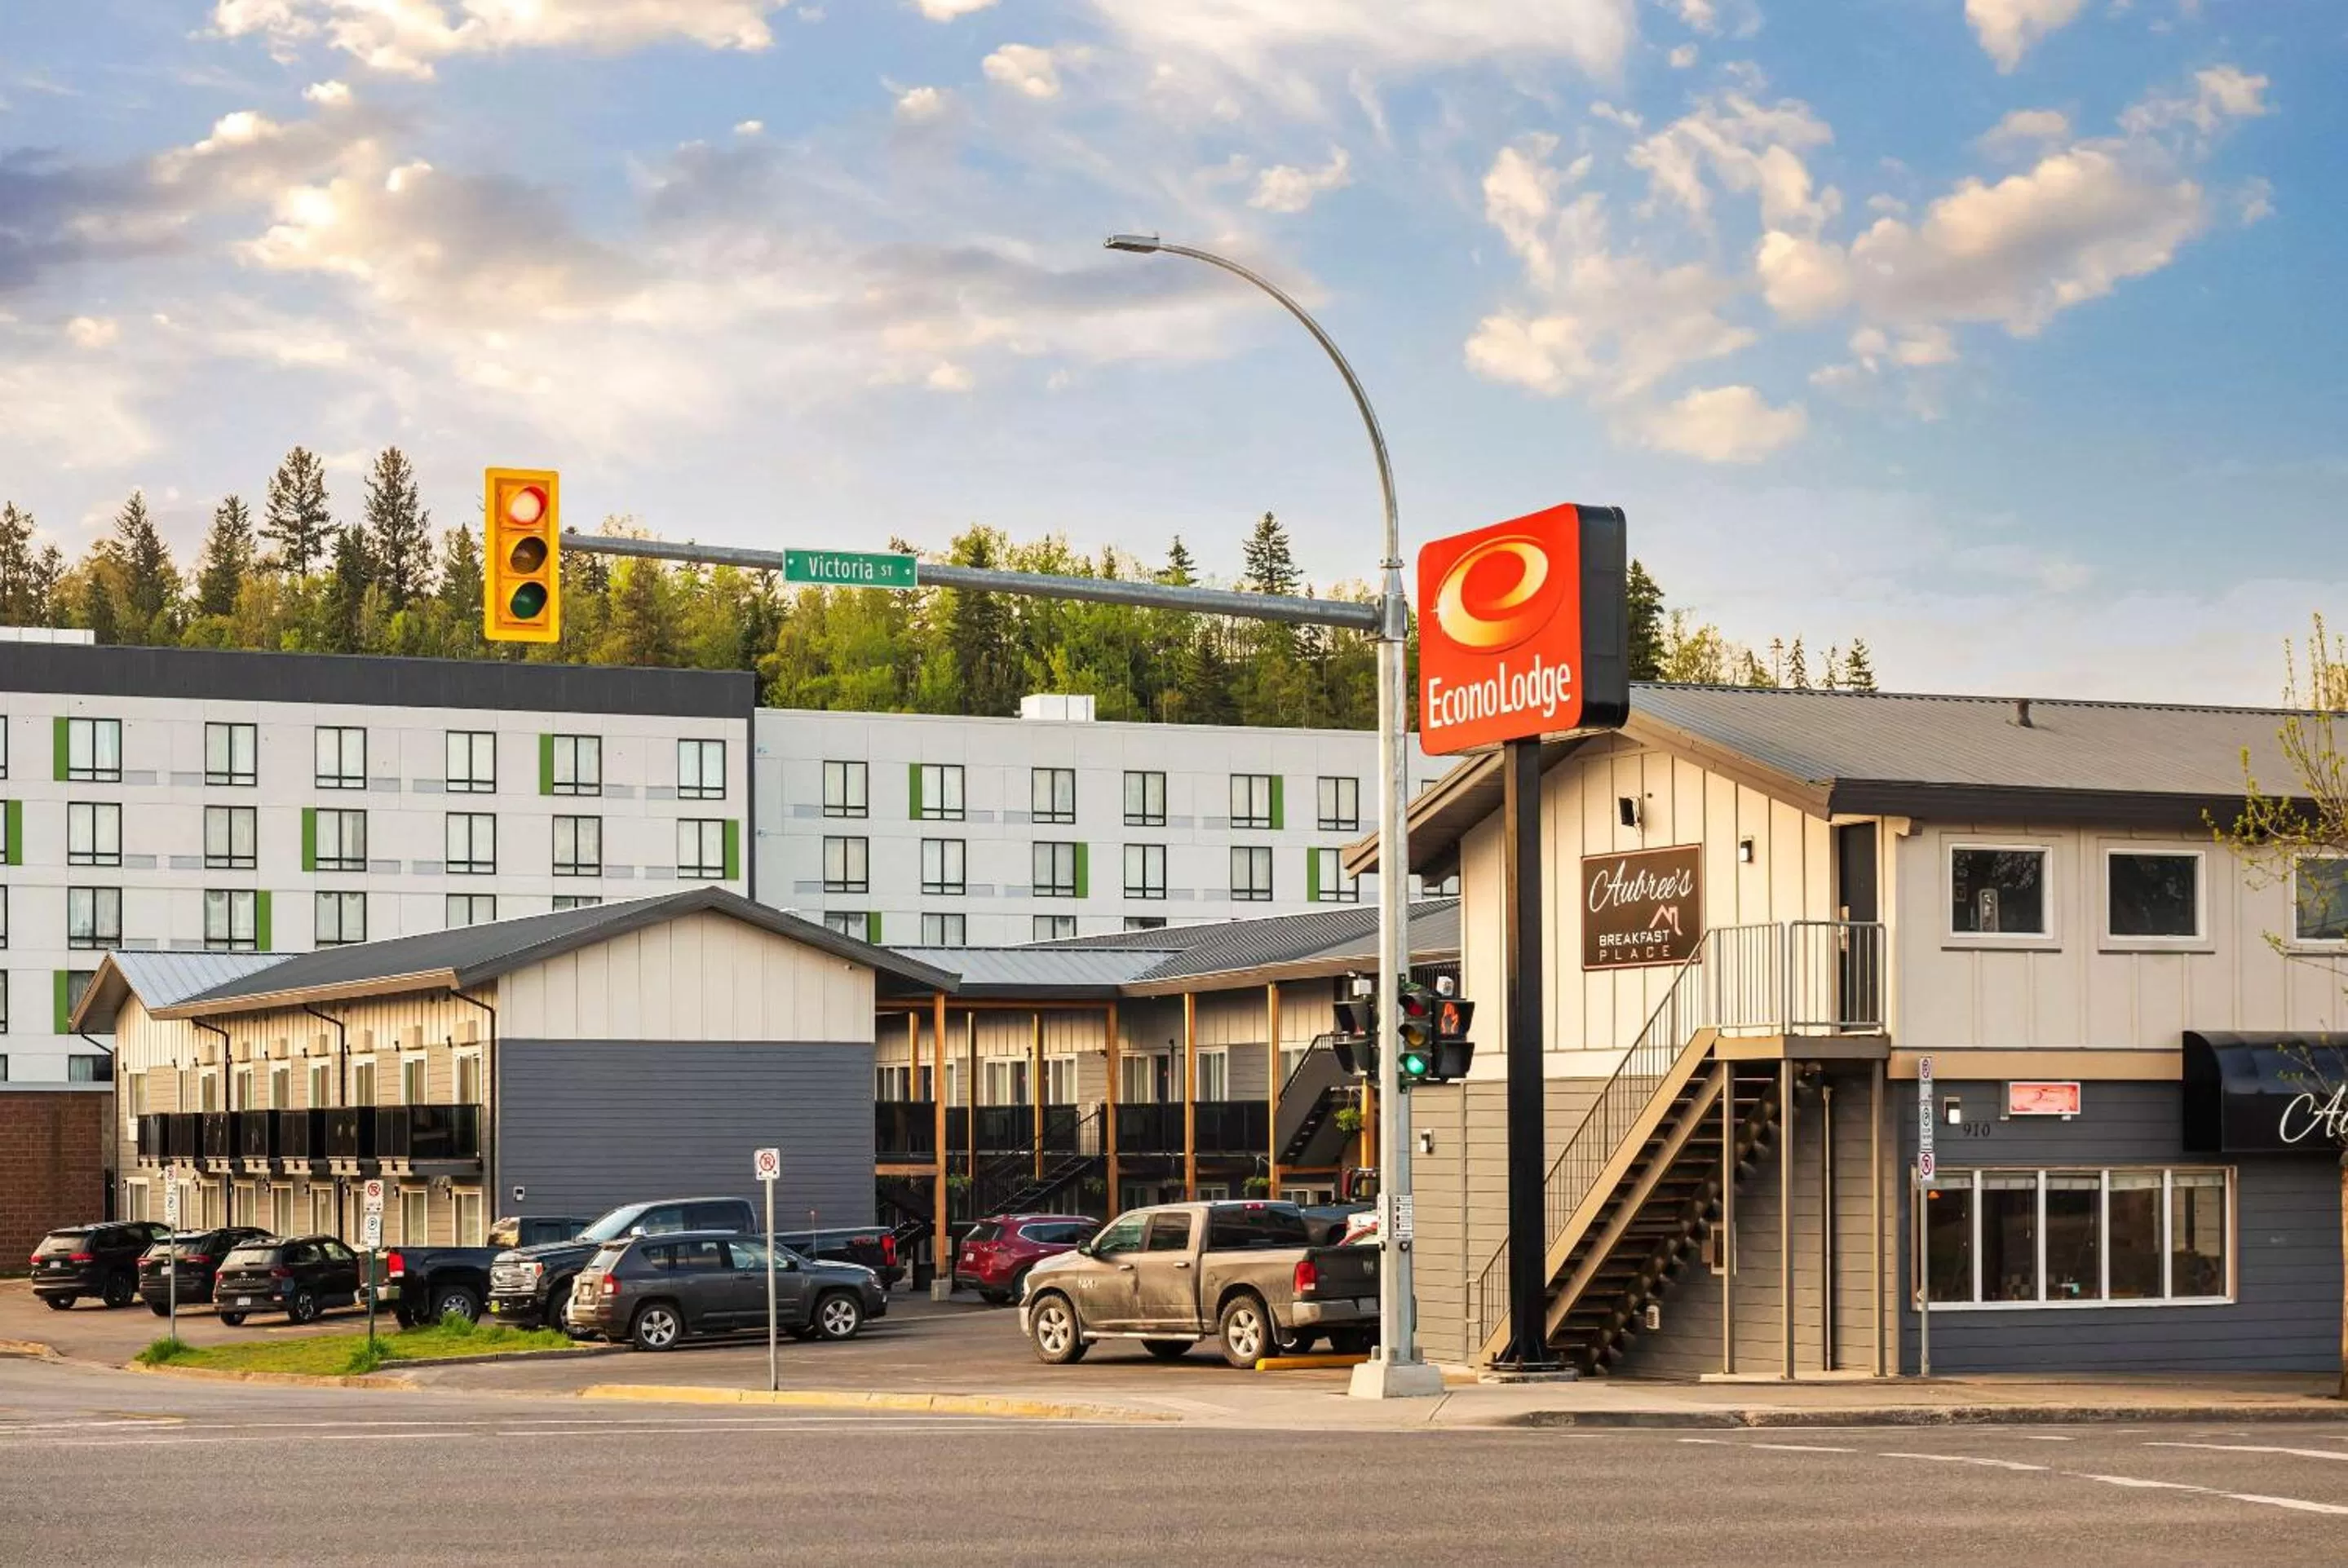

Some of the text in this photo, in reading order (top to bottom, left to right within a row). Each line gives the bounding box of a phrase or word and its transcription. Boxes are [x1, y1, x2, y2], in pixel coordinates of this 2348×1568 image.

[808, 555, 873, 581] Victoria
[1427, 653, 1572, 730] EconoLodge
[1589, 859, 1694, 913] Aubree's
[1598, 929, 1670, 947] BREAKFAST
[1598, 944, 1671, 962] PLACE
[1963, 1122, 1991, 1137] 910
